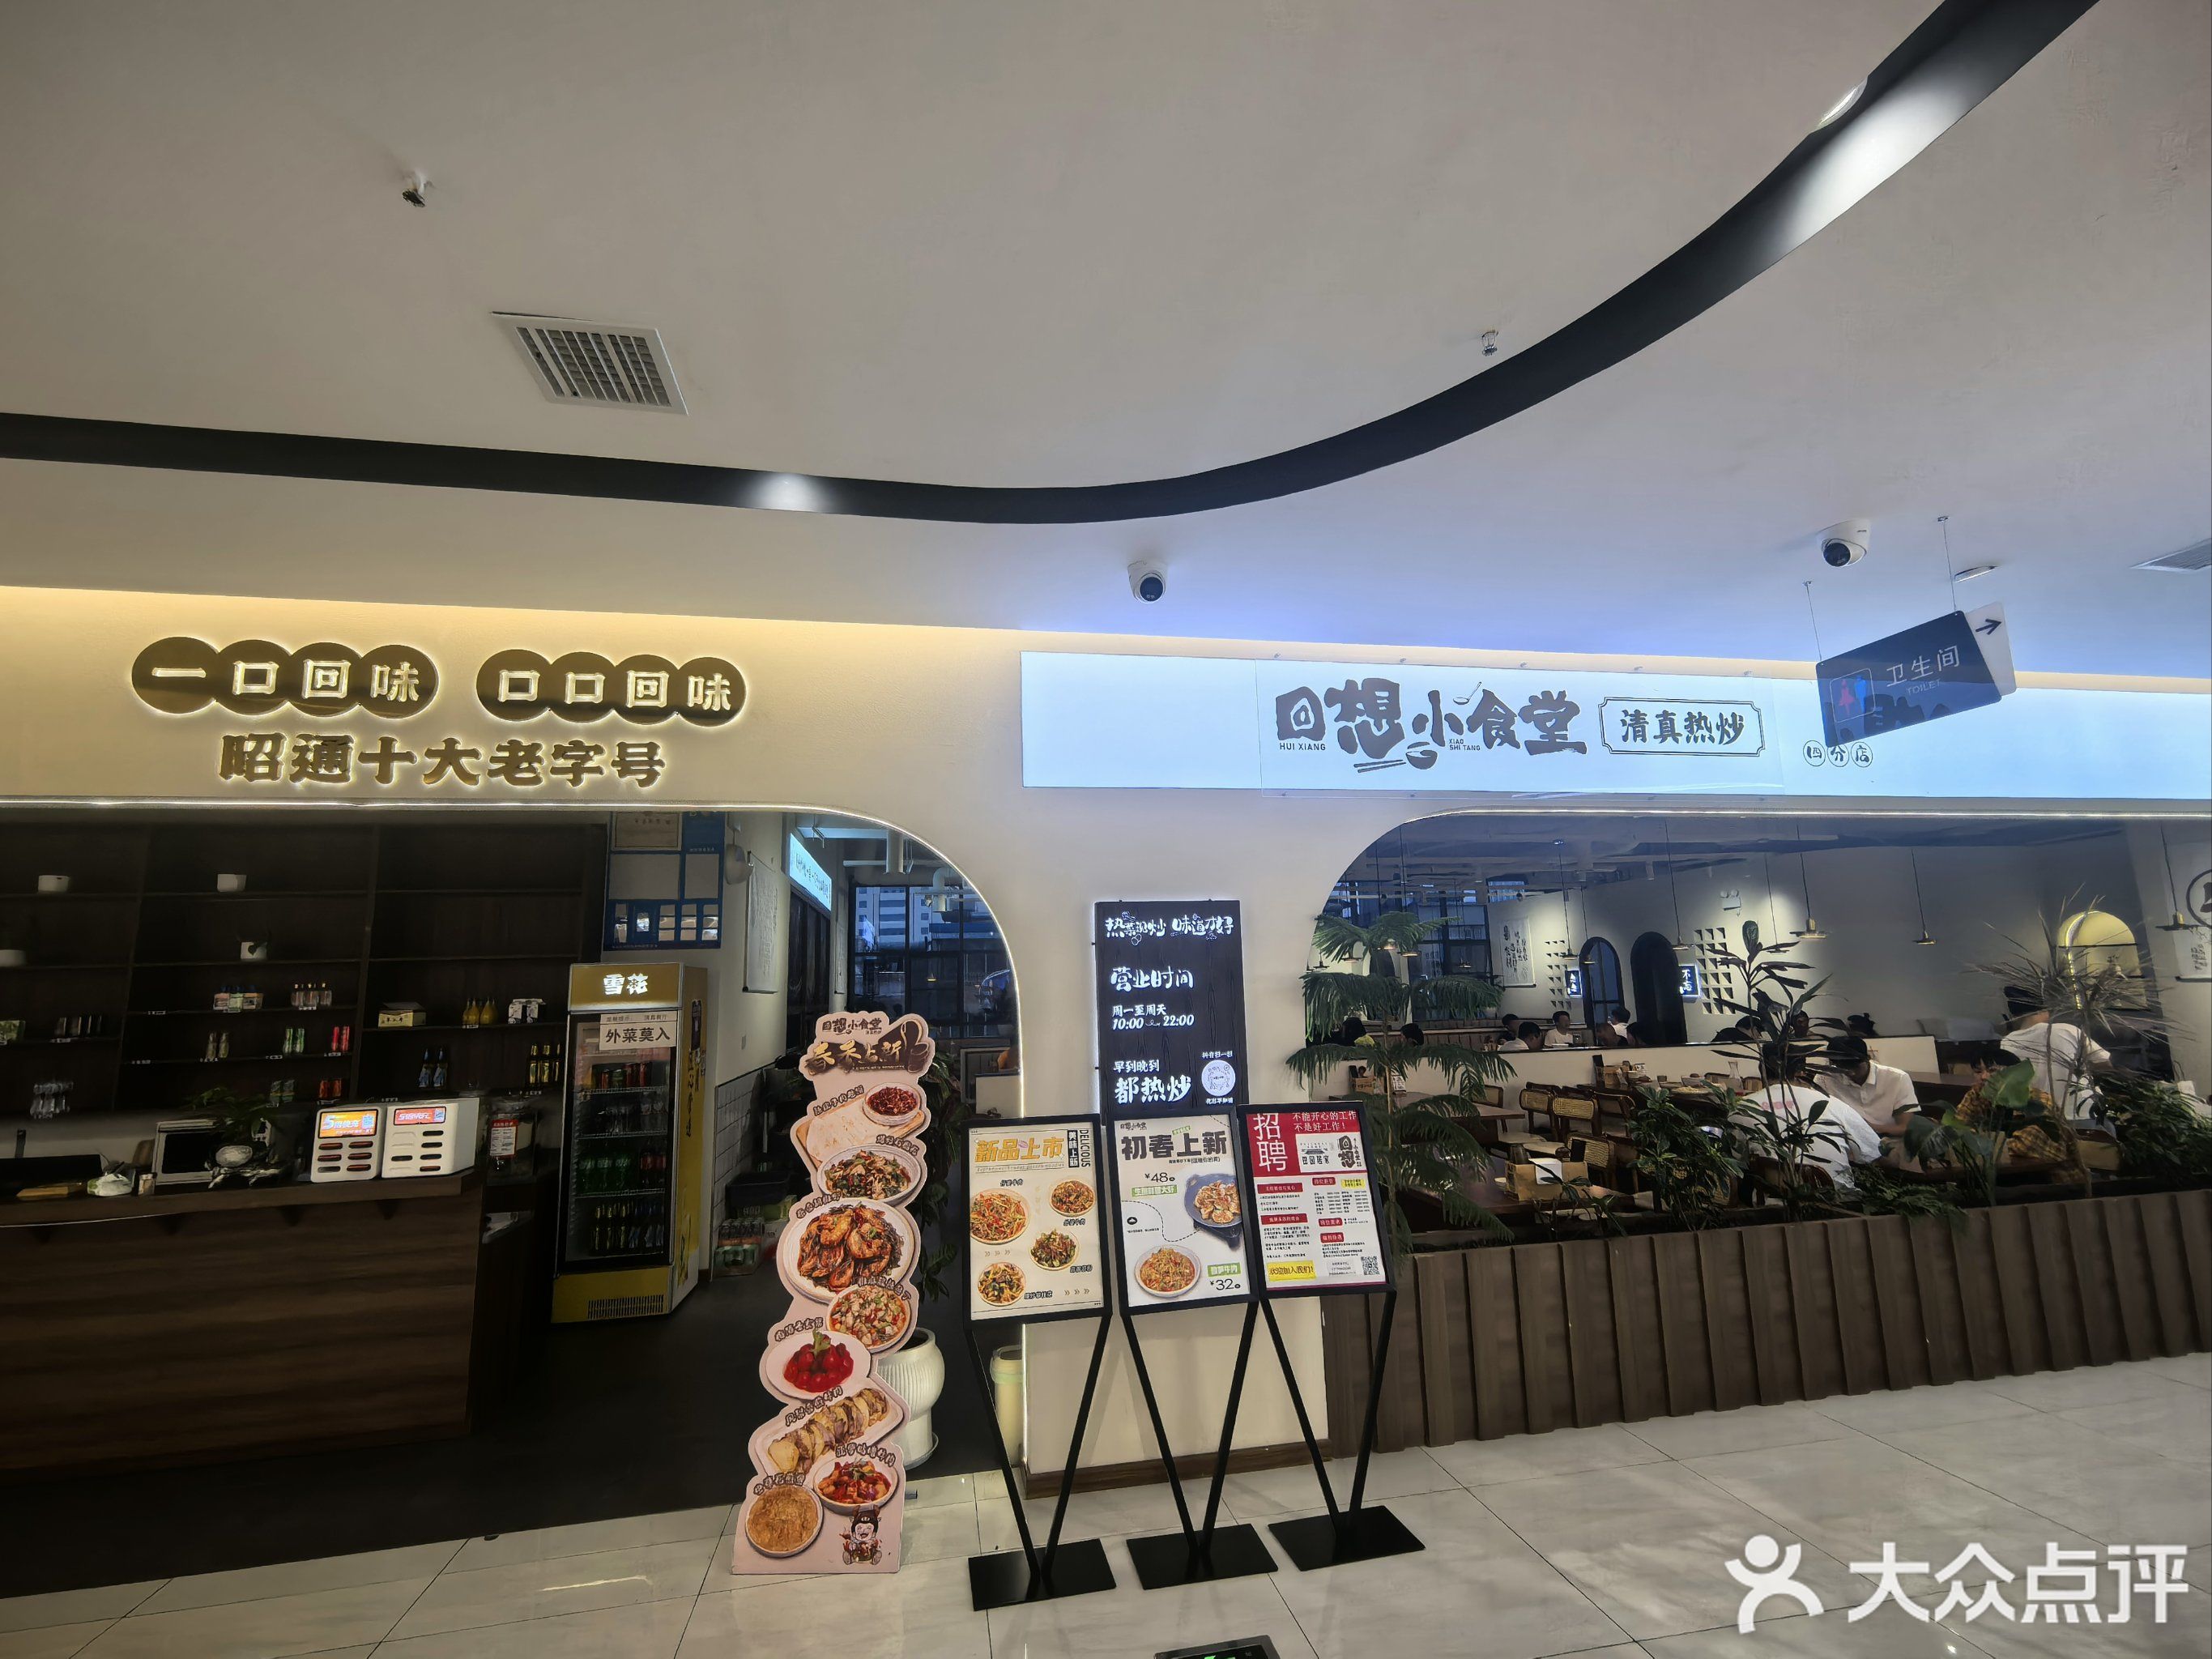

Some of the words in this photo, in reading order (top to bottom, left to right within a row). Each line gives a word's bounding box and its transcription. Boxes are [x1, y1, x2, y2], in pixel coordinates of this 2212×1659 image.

[1886, 645, 1960, 688] 卫生间
[151, 657, 421, 704] 一口回味
[497, 667, 733, 713] 口口回味
[1905, 679, 1941, 697] TOILET
[1275, 677, 1588, 759] 回想小食堂
[1620, 708, 1747, 748] 清真热炒
[219, 731, 667, 787] 昭通十大老字号
[1279, 743, 1295, 752] HUI
[1298, 744, 1327, 752] XIANG
[1805, 744, 1870, 765] 四分店
[603, 973, 649, 996] 雪花
[1110, 966, 1194, 992] 营业时间
[1112, 1004, 1167, 1017] 周一至周天
[1112, 1017, 1144, 1030] 10:00
[1163, 1014, 1195, 1027] 22:00
[605, 1027, 671, 1044] 外菜莫入
[821, 1017, 882, 1034] 回想小食堂
[1113, 1058, 1160, 1073] 早到晚到
[1201, 1050, 1234, 1060] 抖音扫一扫
[1115, 1074, 1192, 1105] 都热炒
[1292, 1110, 1358, 1123] 不能开心的工作
[974, 1136, 1065, 1163] 新品上市
[1079, 1129, 1091, 1168] DELICIOUS
[1121, 1130, 1227, 1161] 初春上新
[1253, 1112, 1289, 1172] 招聘
